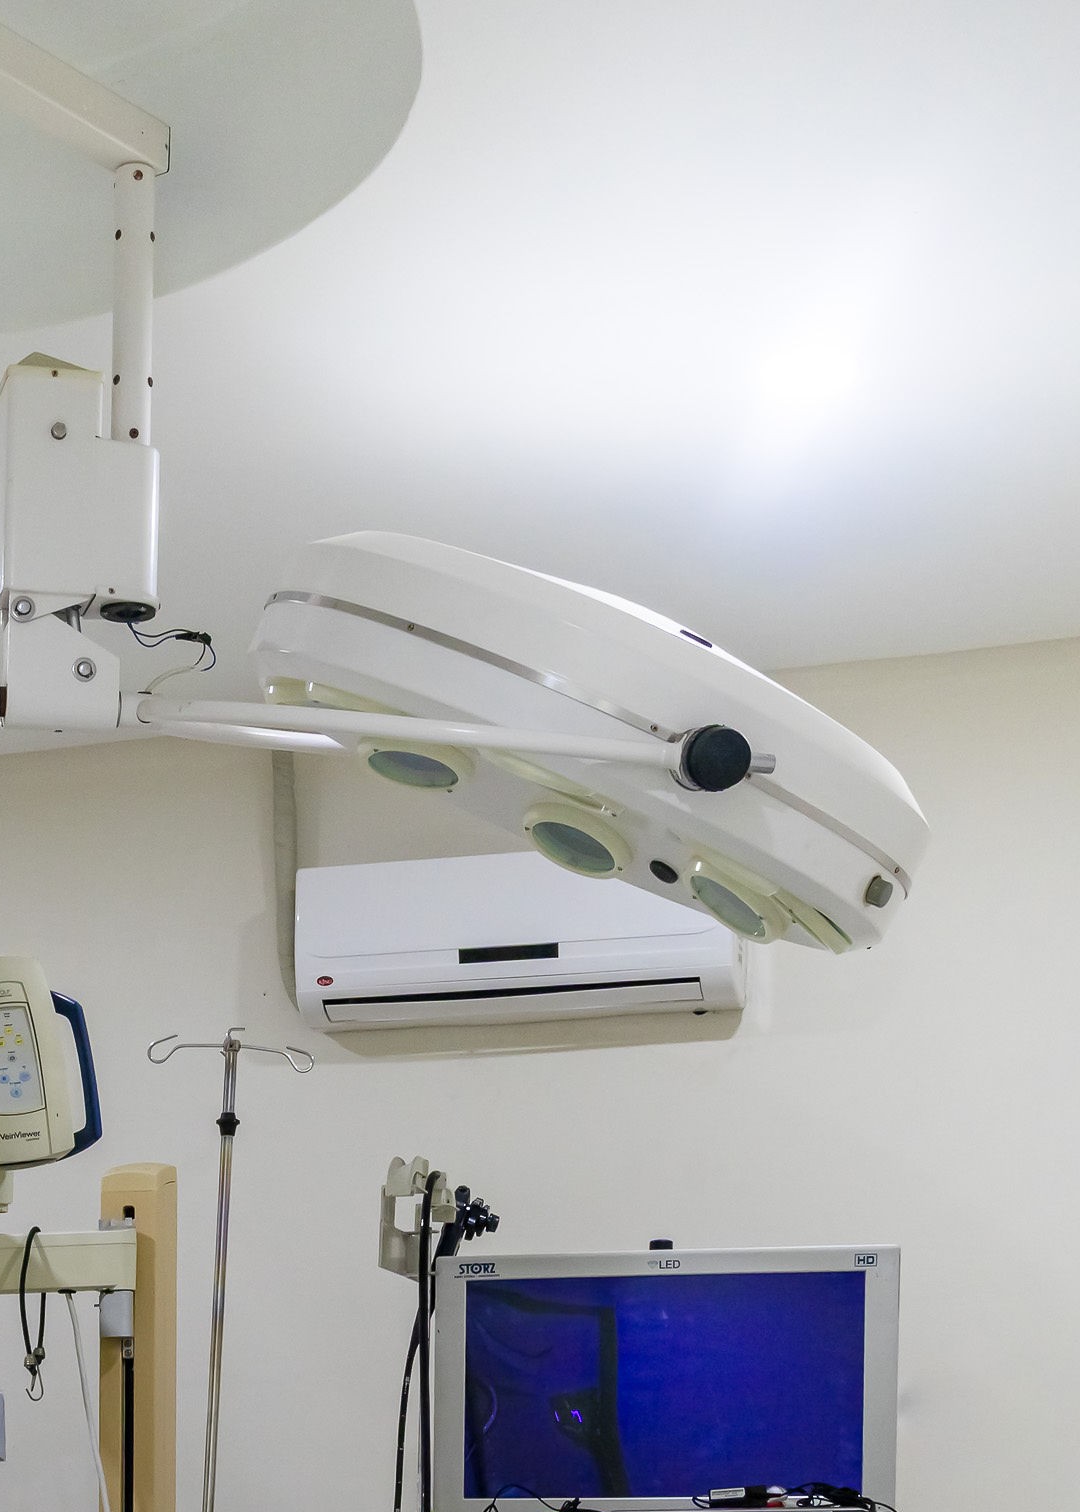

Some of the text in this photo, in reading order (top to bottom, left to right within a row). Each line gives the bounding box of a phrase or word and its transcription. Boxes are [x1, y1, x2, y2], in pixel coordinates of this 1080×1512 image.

[0, 1130, 40, 1141] VeinViewer
[659, 1259, 681, 1270] LED
[857, 1255, 875, 1265] HD
[458, 1262, 496, 1275] STORZ
